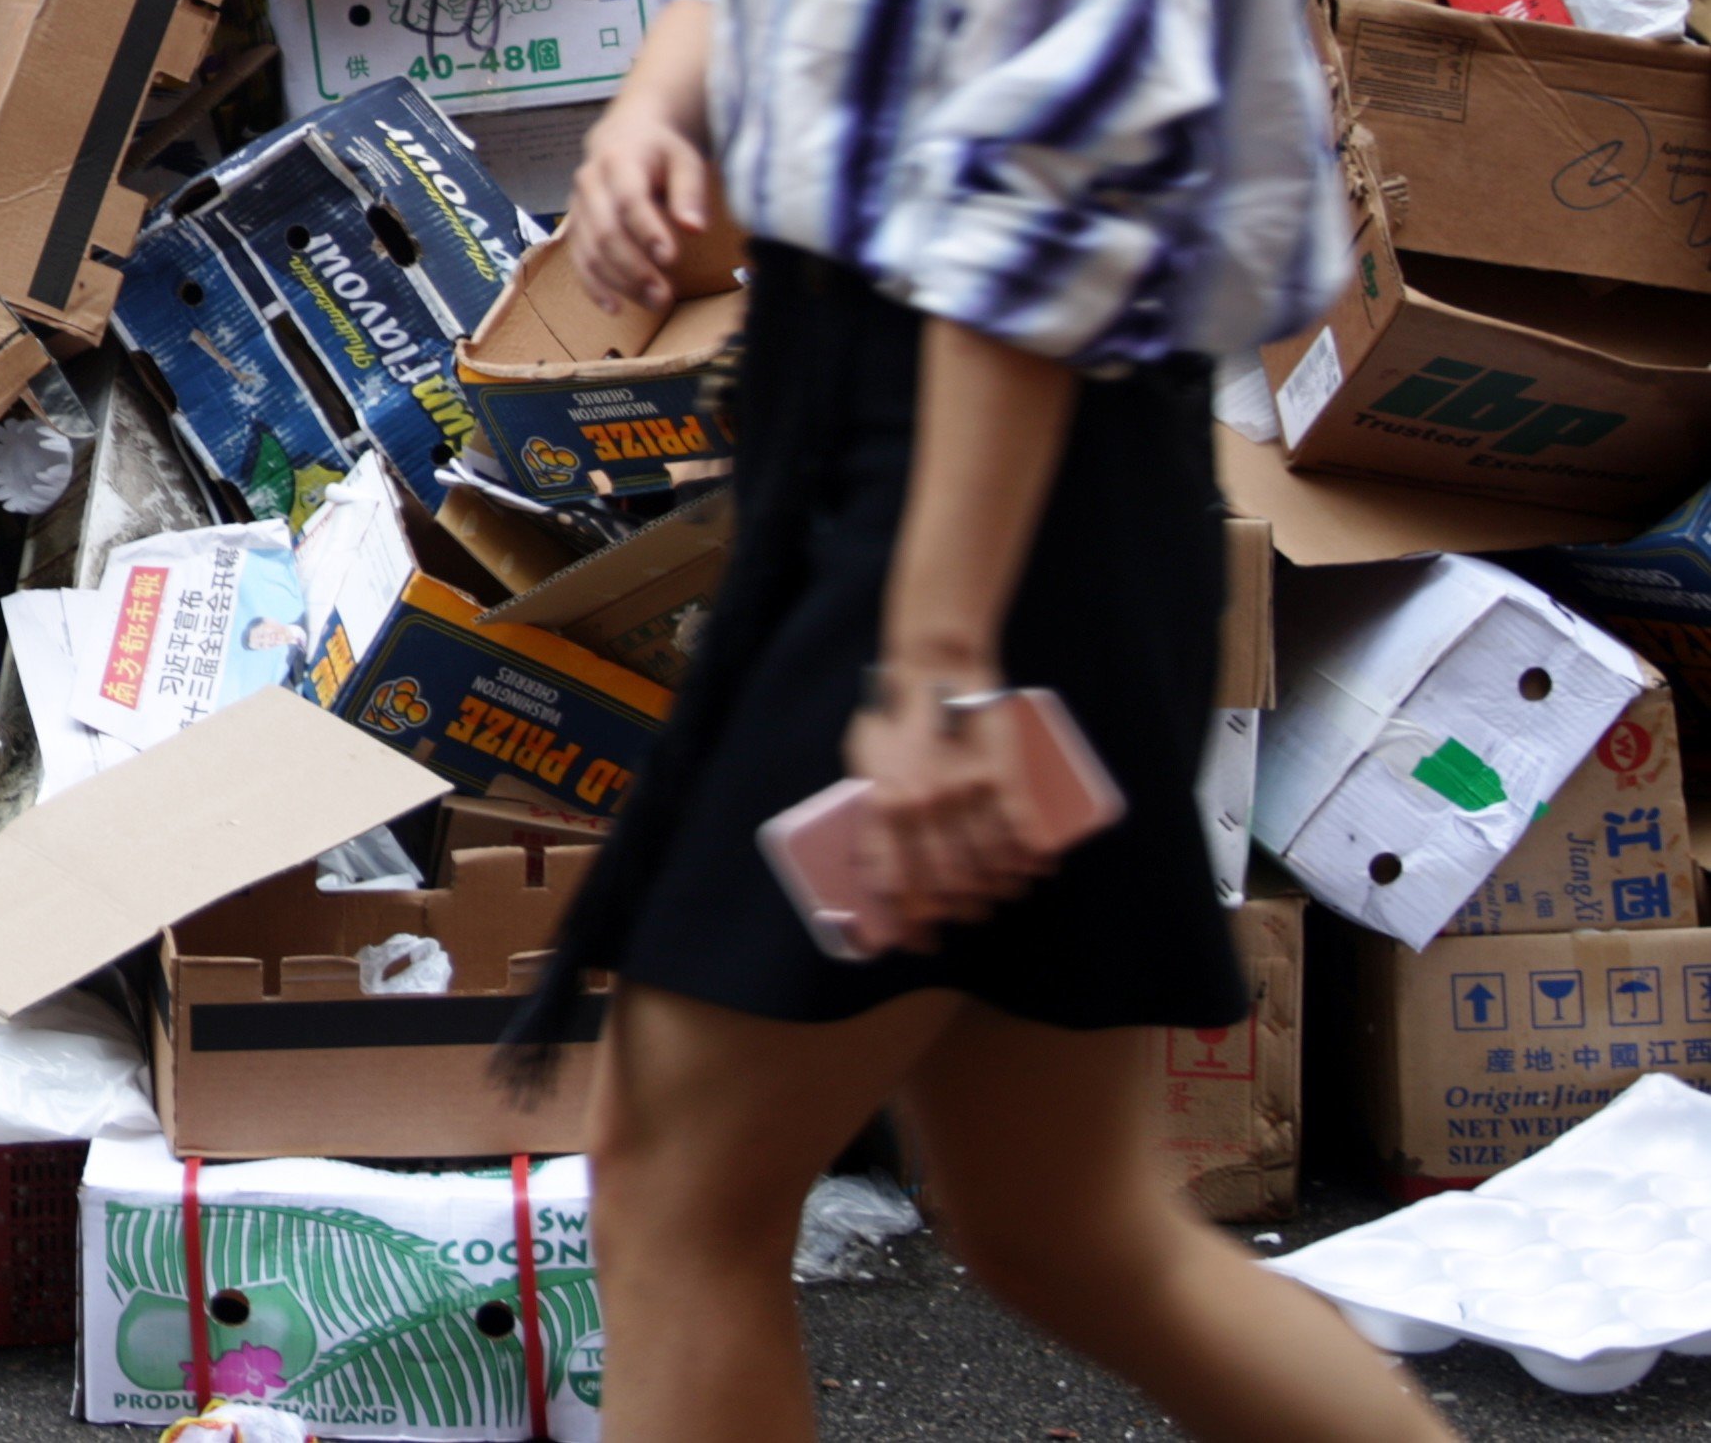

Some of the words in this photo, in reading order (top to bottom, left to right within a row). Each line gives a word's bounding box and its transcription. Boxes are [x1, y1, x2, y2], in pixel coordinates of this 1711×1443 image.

[568, 399, 658, 425] WASHINGTON
[573, 388, 633, 404] CHERRIES
[1368, 356, 1629, 456] ibp
[580, 414, 713, 466] PRIZE
[1353, 411, 1481, 449] Trusted
[1466, 453, 1647, 484] Excellence
[102, 566, 167, 709] 南方都市報
[157, 588, 205, 698] 习近平宣布
[471, 673, 564, 725] WASHINGTON
[495, 664, 559, 704] CHERRIES
[445, 695, 583, 789] PRIZE
[1565, 830, 1604, 924] JiangXi
[1602, 806, 1672, 923] 江西
[1447, 1118, 1504, 1140] NET
[1448, 1145, 1507, 1166] SIZE
